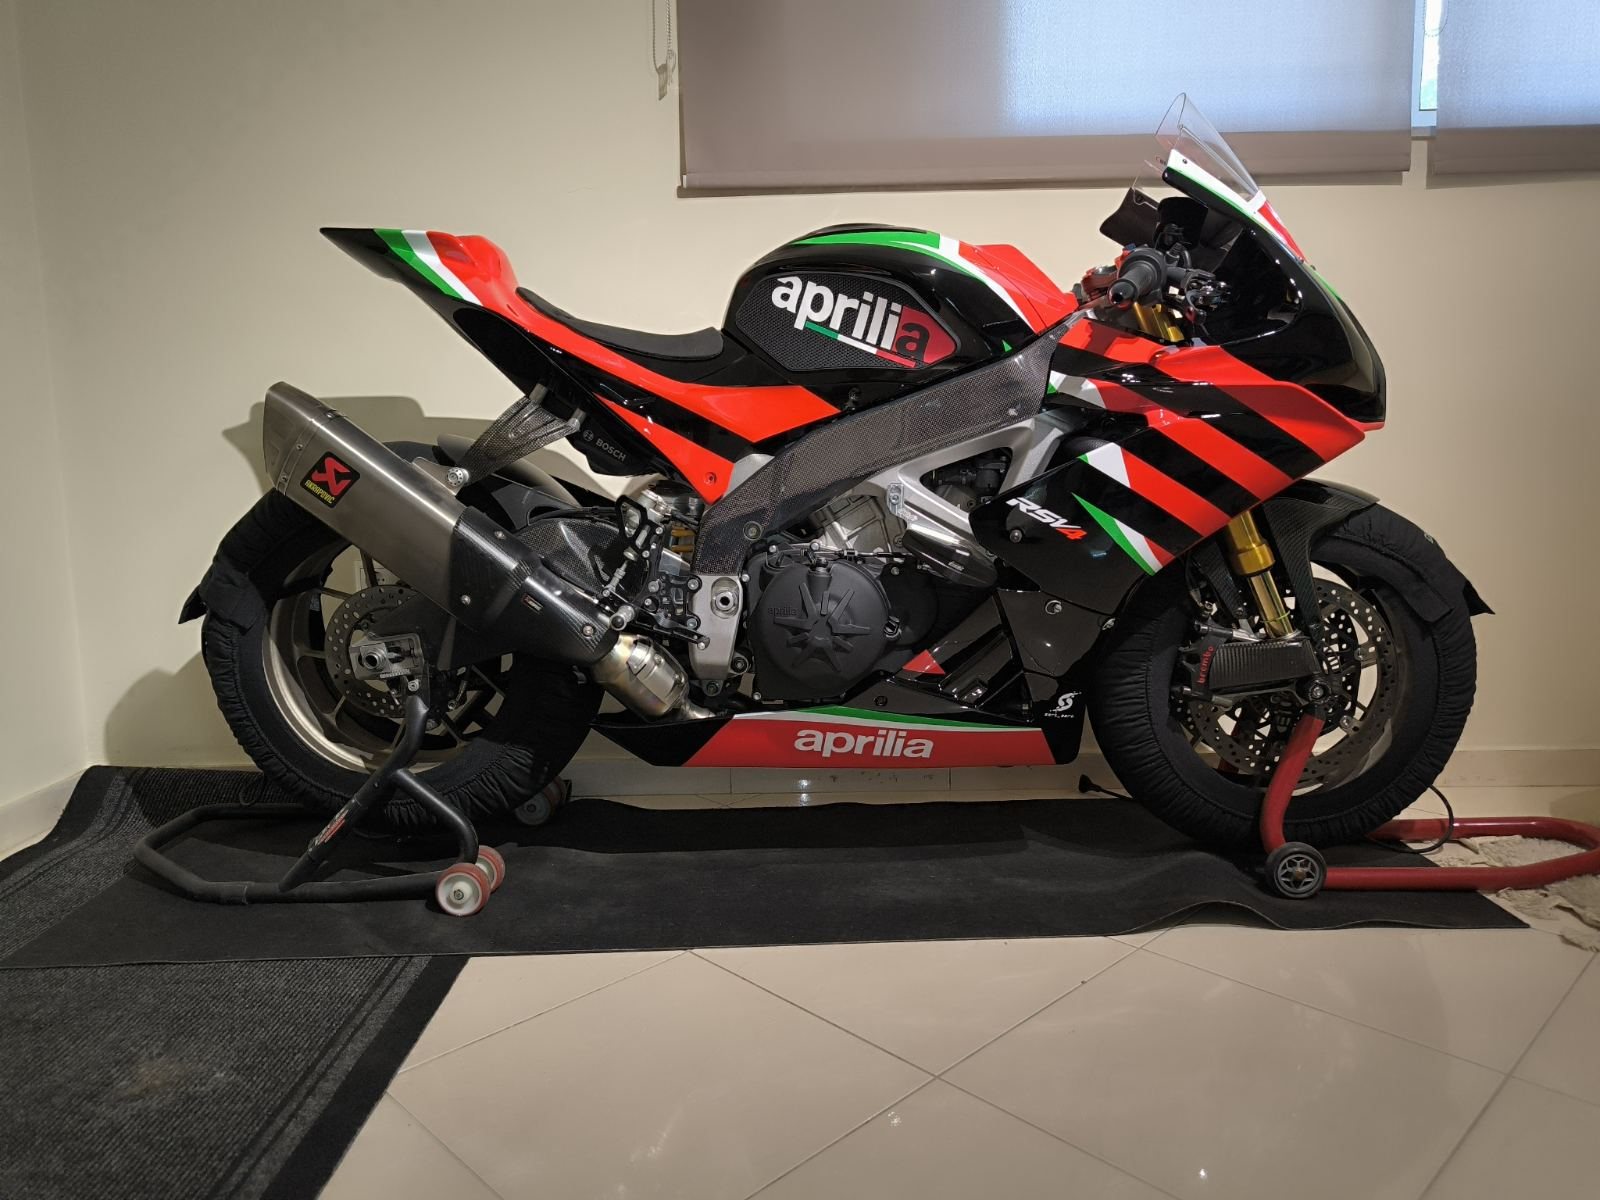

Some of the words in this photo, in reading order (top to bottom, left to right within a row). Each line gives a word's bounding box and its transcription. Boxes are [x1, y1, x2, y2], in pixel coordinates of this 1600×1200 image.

[771, 276, 930, 362] aprilia
[595, 438, 627, 462] BOSCH
[1005, 497, 1088, 540] RSV4
[1196, 645, 1214, 684] brembo
[793, 729, 935, 759] aprilia
